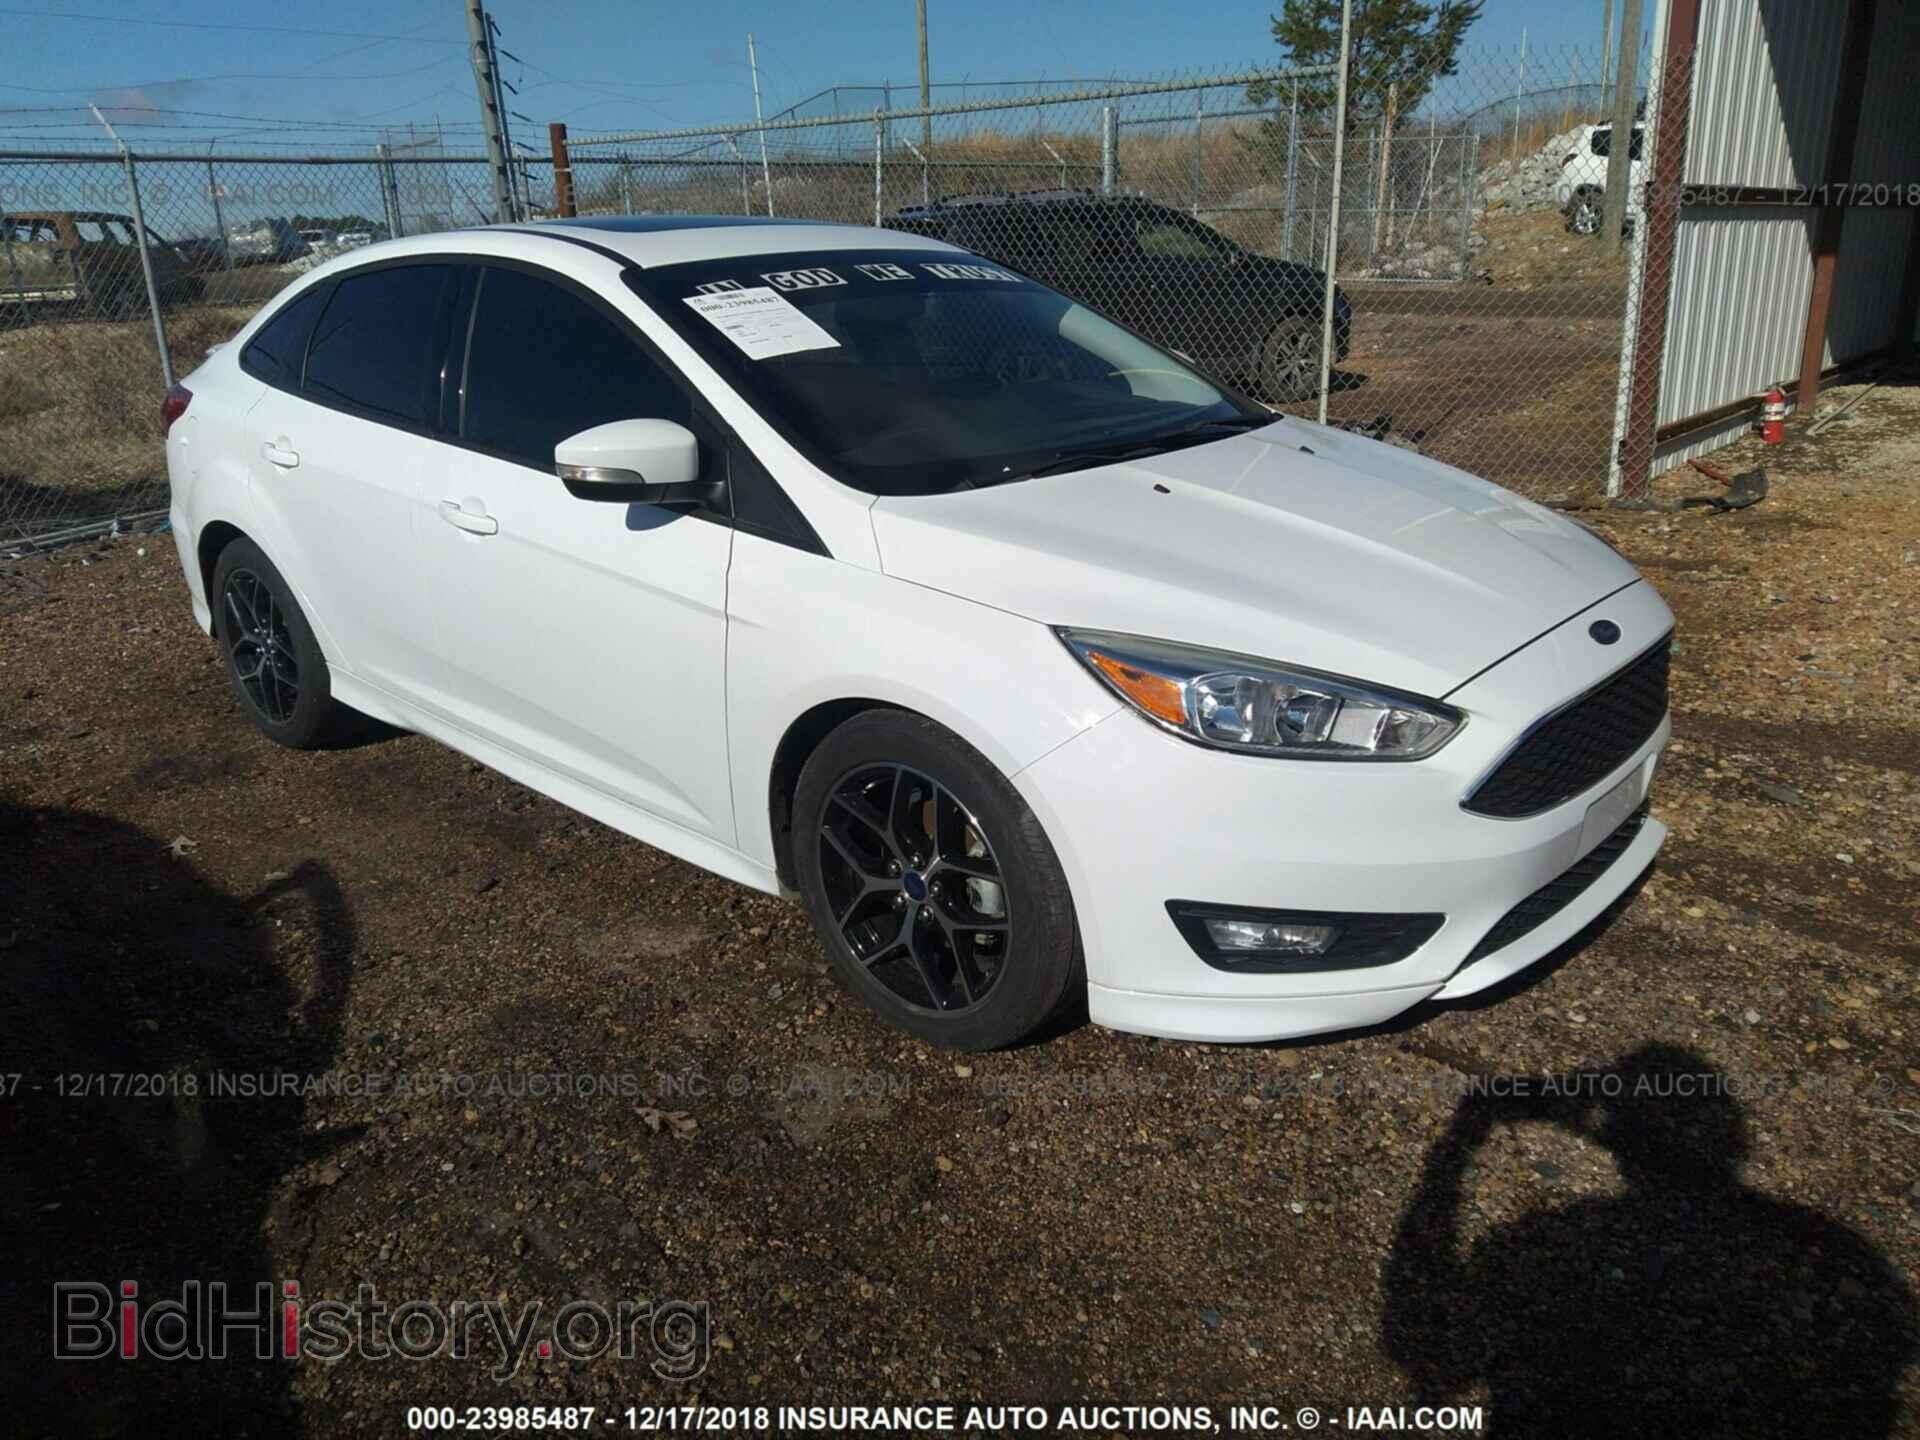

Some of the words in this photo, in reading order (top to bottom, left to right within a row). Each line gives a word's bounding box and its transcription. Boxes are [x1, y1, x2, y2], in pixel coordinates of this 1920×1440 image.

[763, 268, 846, 292] GOD
[857, 264, 915, 281] WE
[922, 264, 1022, 283] TRUST
